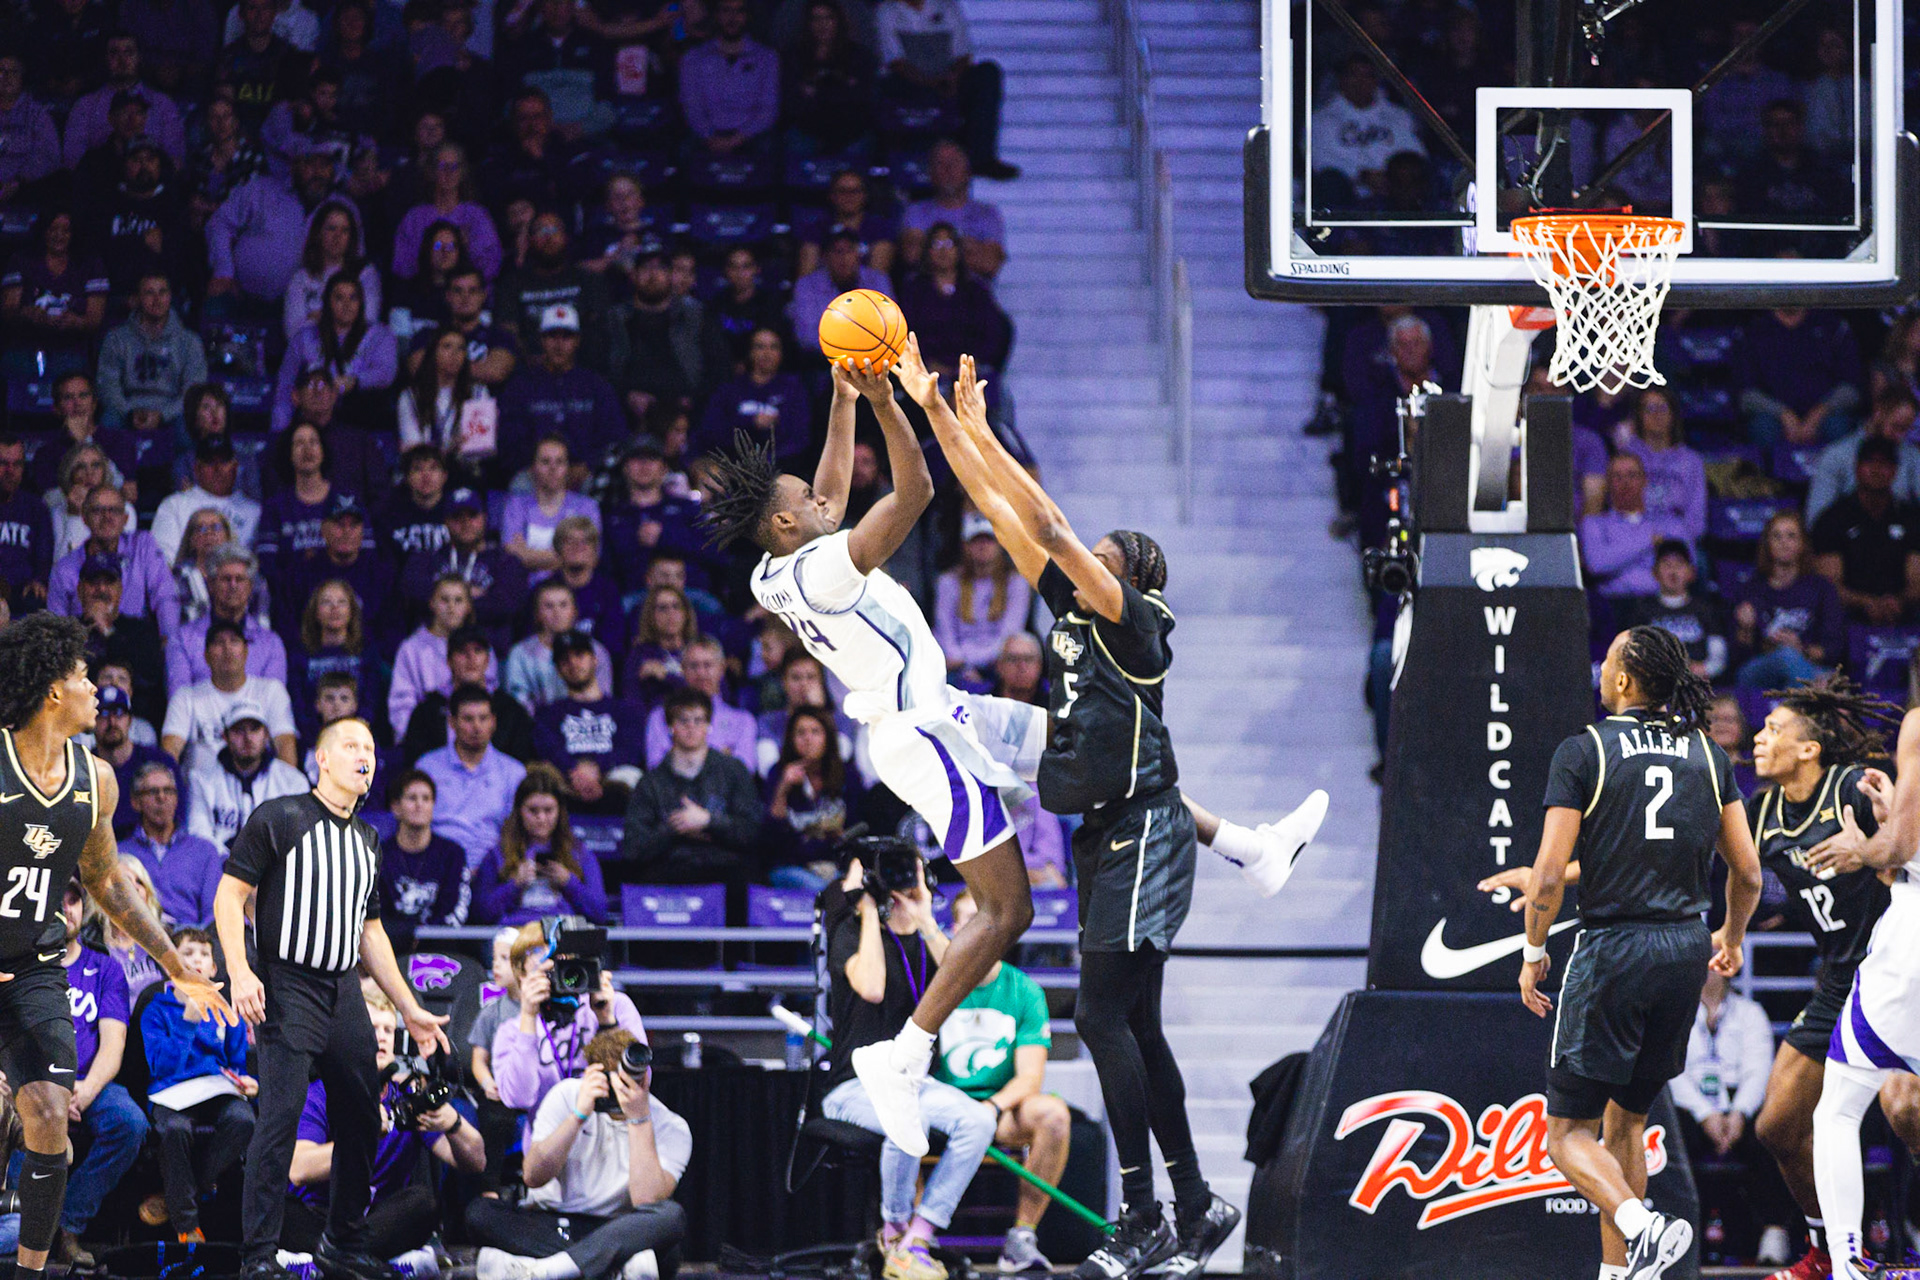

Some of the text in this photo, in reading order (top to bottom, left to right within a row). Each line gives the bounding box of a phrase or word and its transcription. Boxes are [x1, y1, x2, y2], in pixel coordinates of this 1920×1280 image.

[1291, 262, 1350, 277] SPALDING
[1052, 631, 1084, 667] UCF
[1057, 671, 1079, 719] 5
[1619, 728, 1690, 759] ALLEN
[1645, 765, 1674, 839] 2
[22, 823, 63, 860] UCF
[0, 866, 52, 922] 24
[1799, 884, 1847, 932] 12
